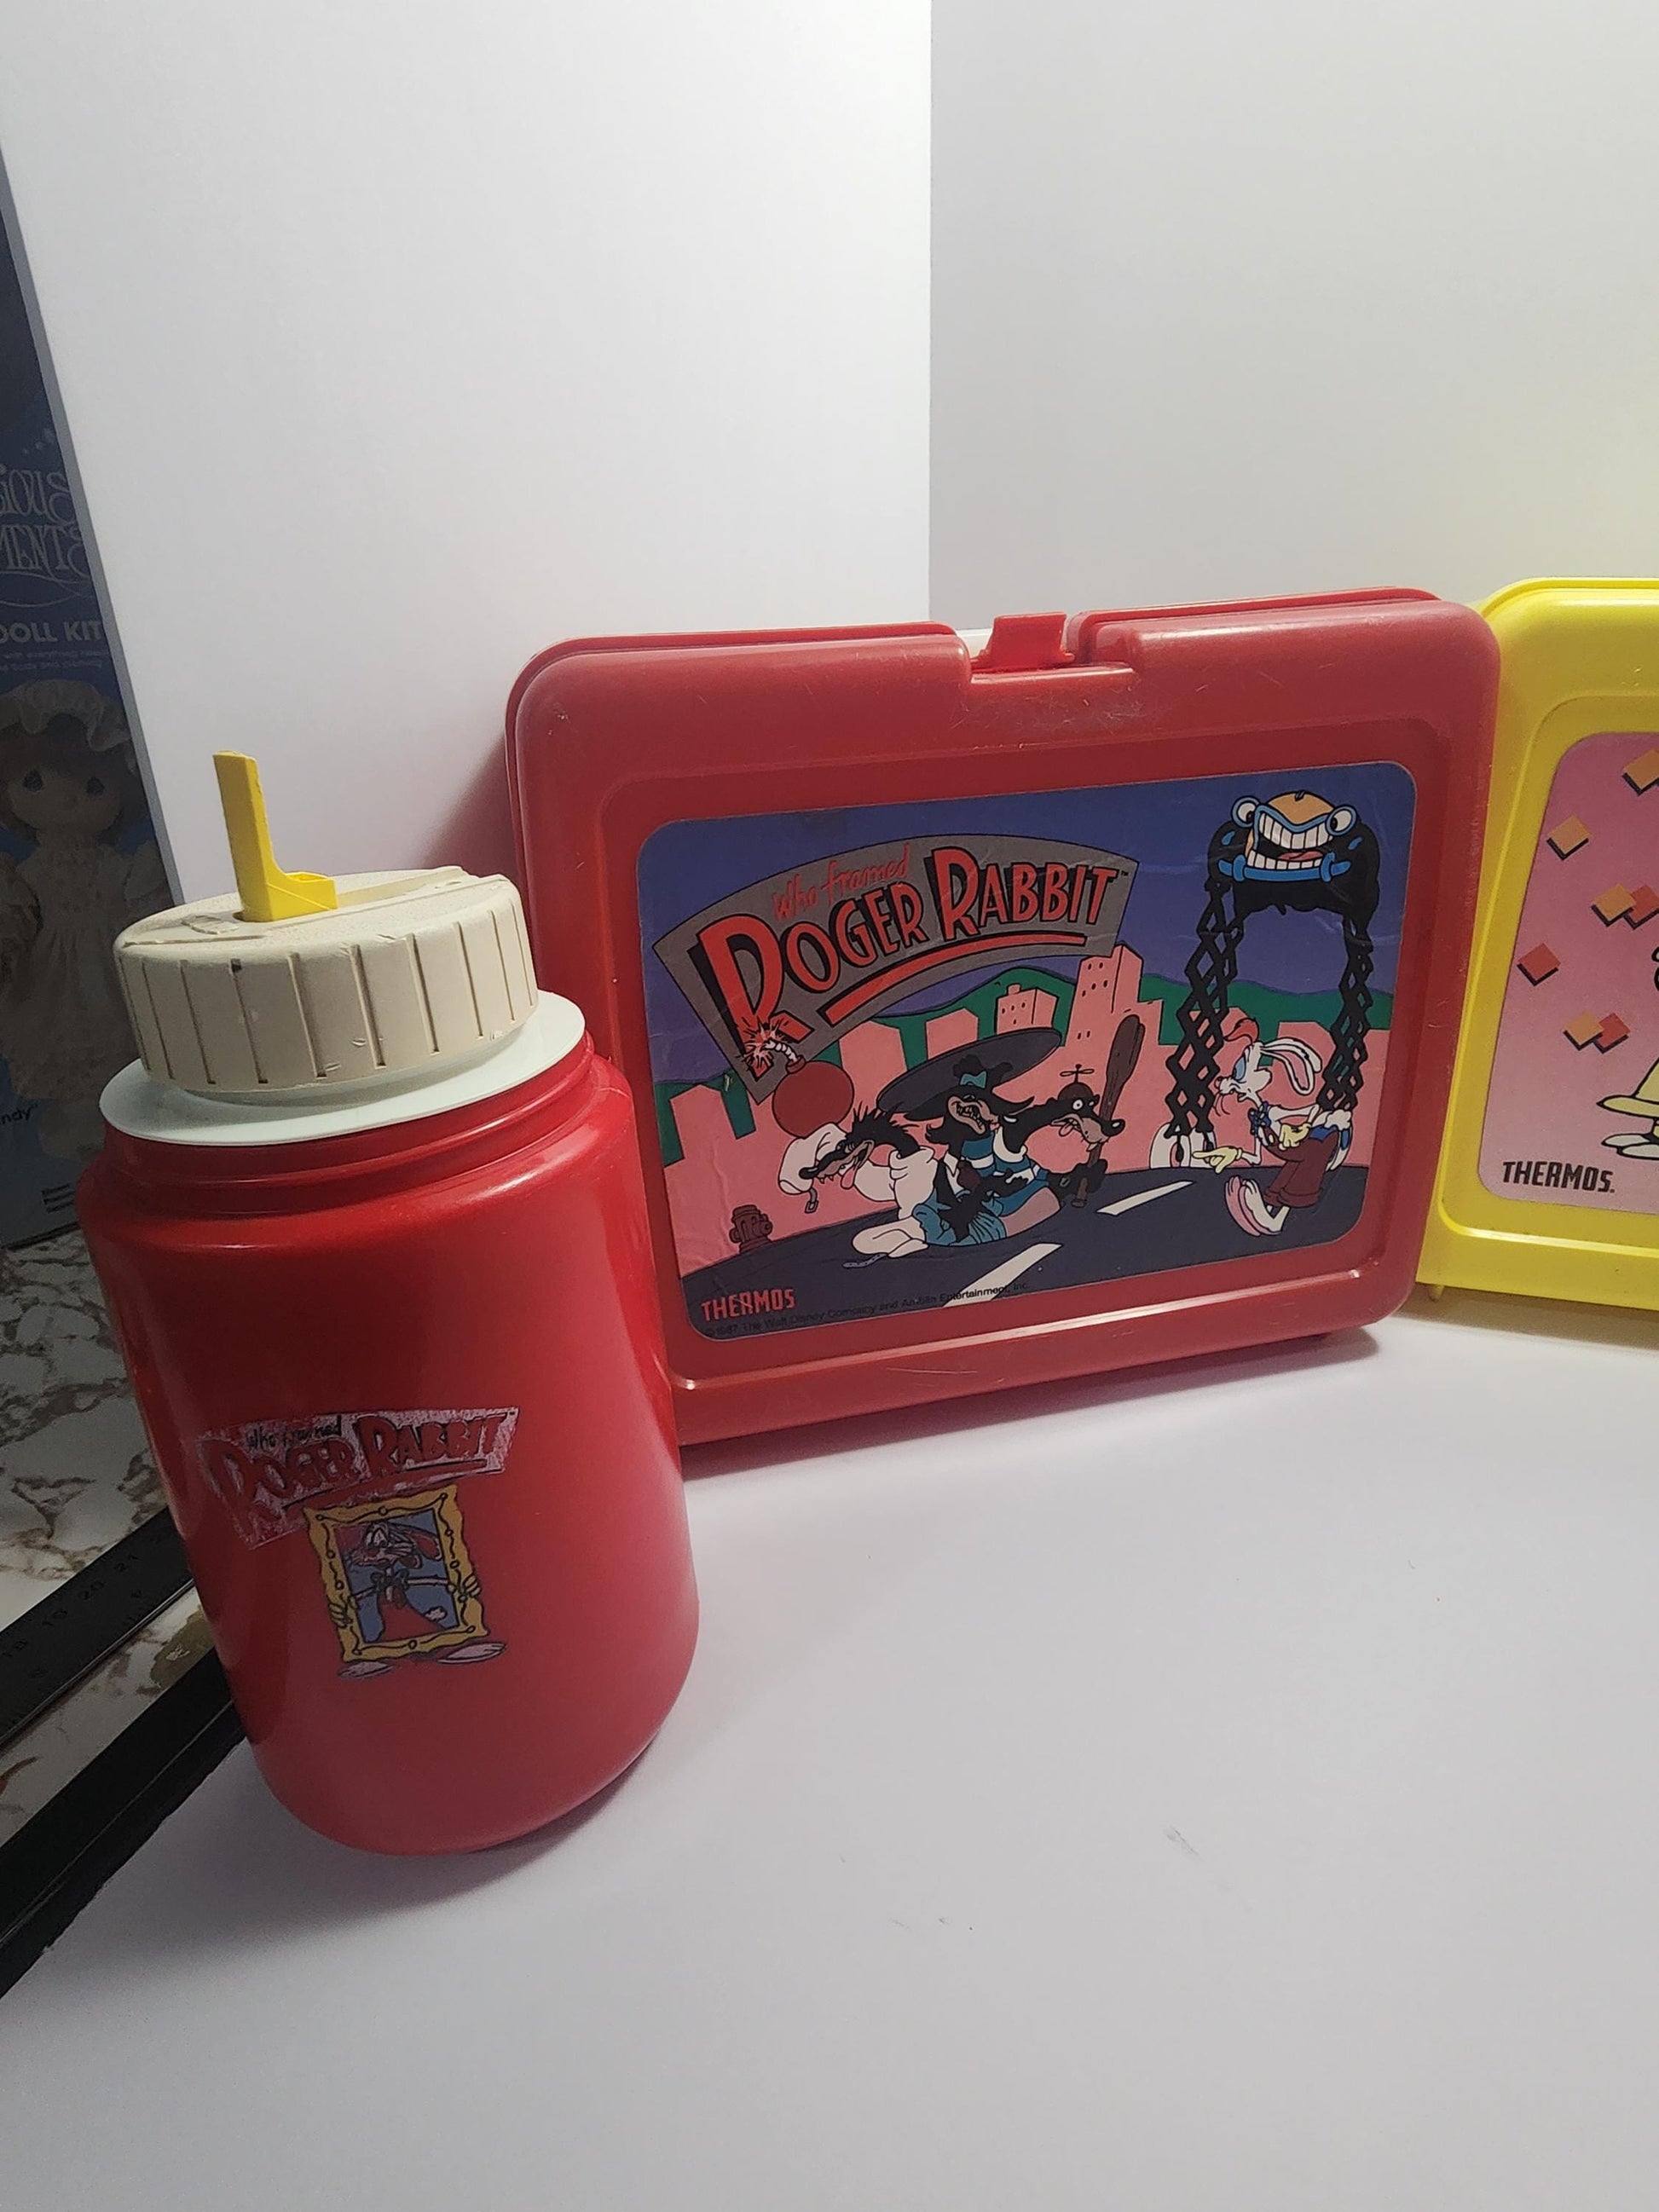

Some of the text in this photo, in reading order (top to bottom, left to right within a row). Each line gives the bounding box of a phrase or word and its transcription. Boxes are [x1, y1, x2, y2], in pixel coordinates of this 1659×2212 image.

[0, 465, 74, 526] iOUS
[63, 621, 101, 642] KIT
[686, 883, 928, 1081] ROGER
[700, 1288, 796, 1322] THERMOS
[827, 1303, 876, 1320] Company
[880, 1299, 899, 1310] and
